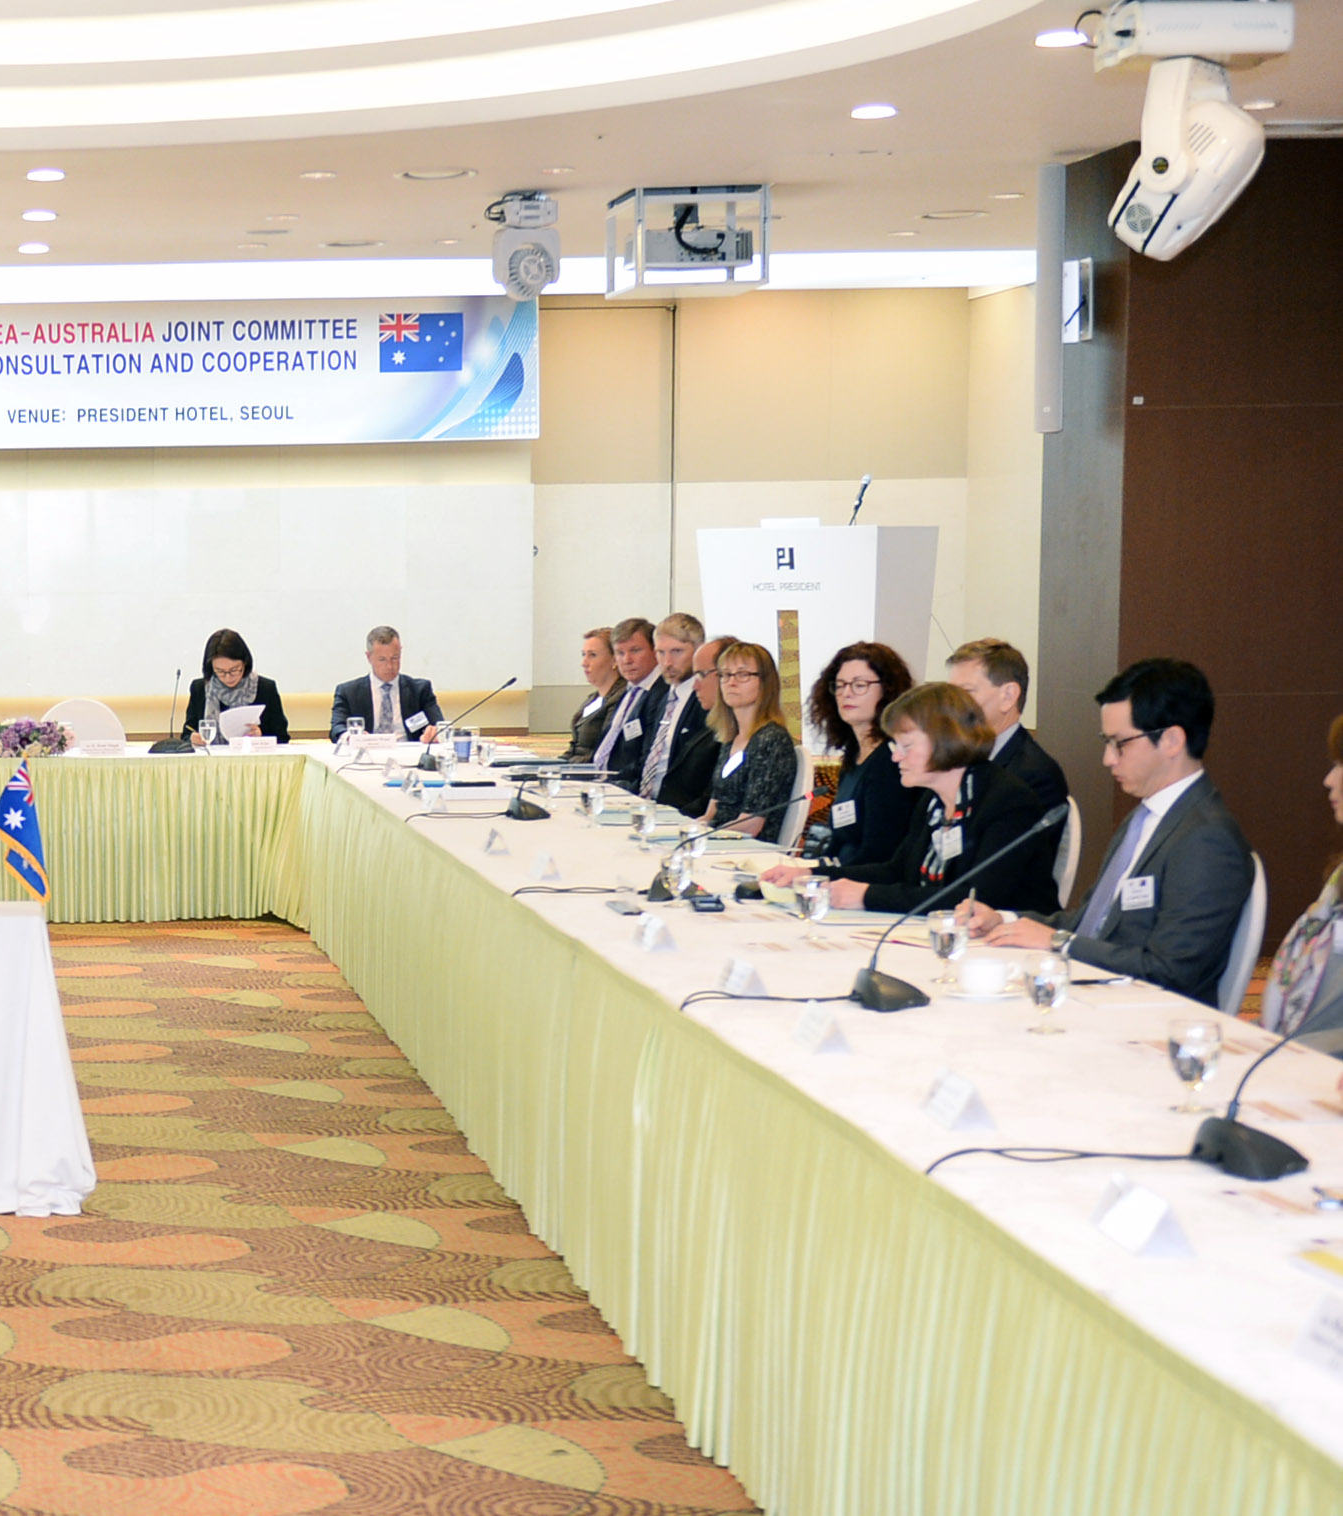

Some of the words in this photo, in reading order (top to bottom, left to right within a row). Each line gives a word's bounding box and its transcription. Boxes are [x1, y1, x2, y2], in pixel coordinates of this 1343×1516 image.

[161, 320, 225, 343] JOINT
[232, 319, 358, 341] COMMITTEE
[149, 352, 194, 374] AND
[201, 349, 357, 373] COOPERATION
[6, 408, 66, 424] VENUE:
[77, 406, 170, 423] PRESIDENT
[174, 405, 234, 423] HOTEL,
[239, 404, 295, 421] SEOUL
[752, 582, 777, 591] HOTEL
[779, 582, 821, 591] PRESIDENT
